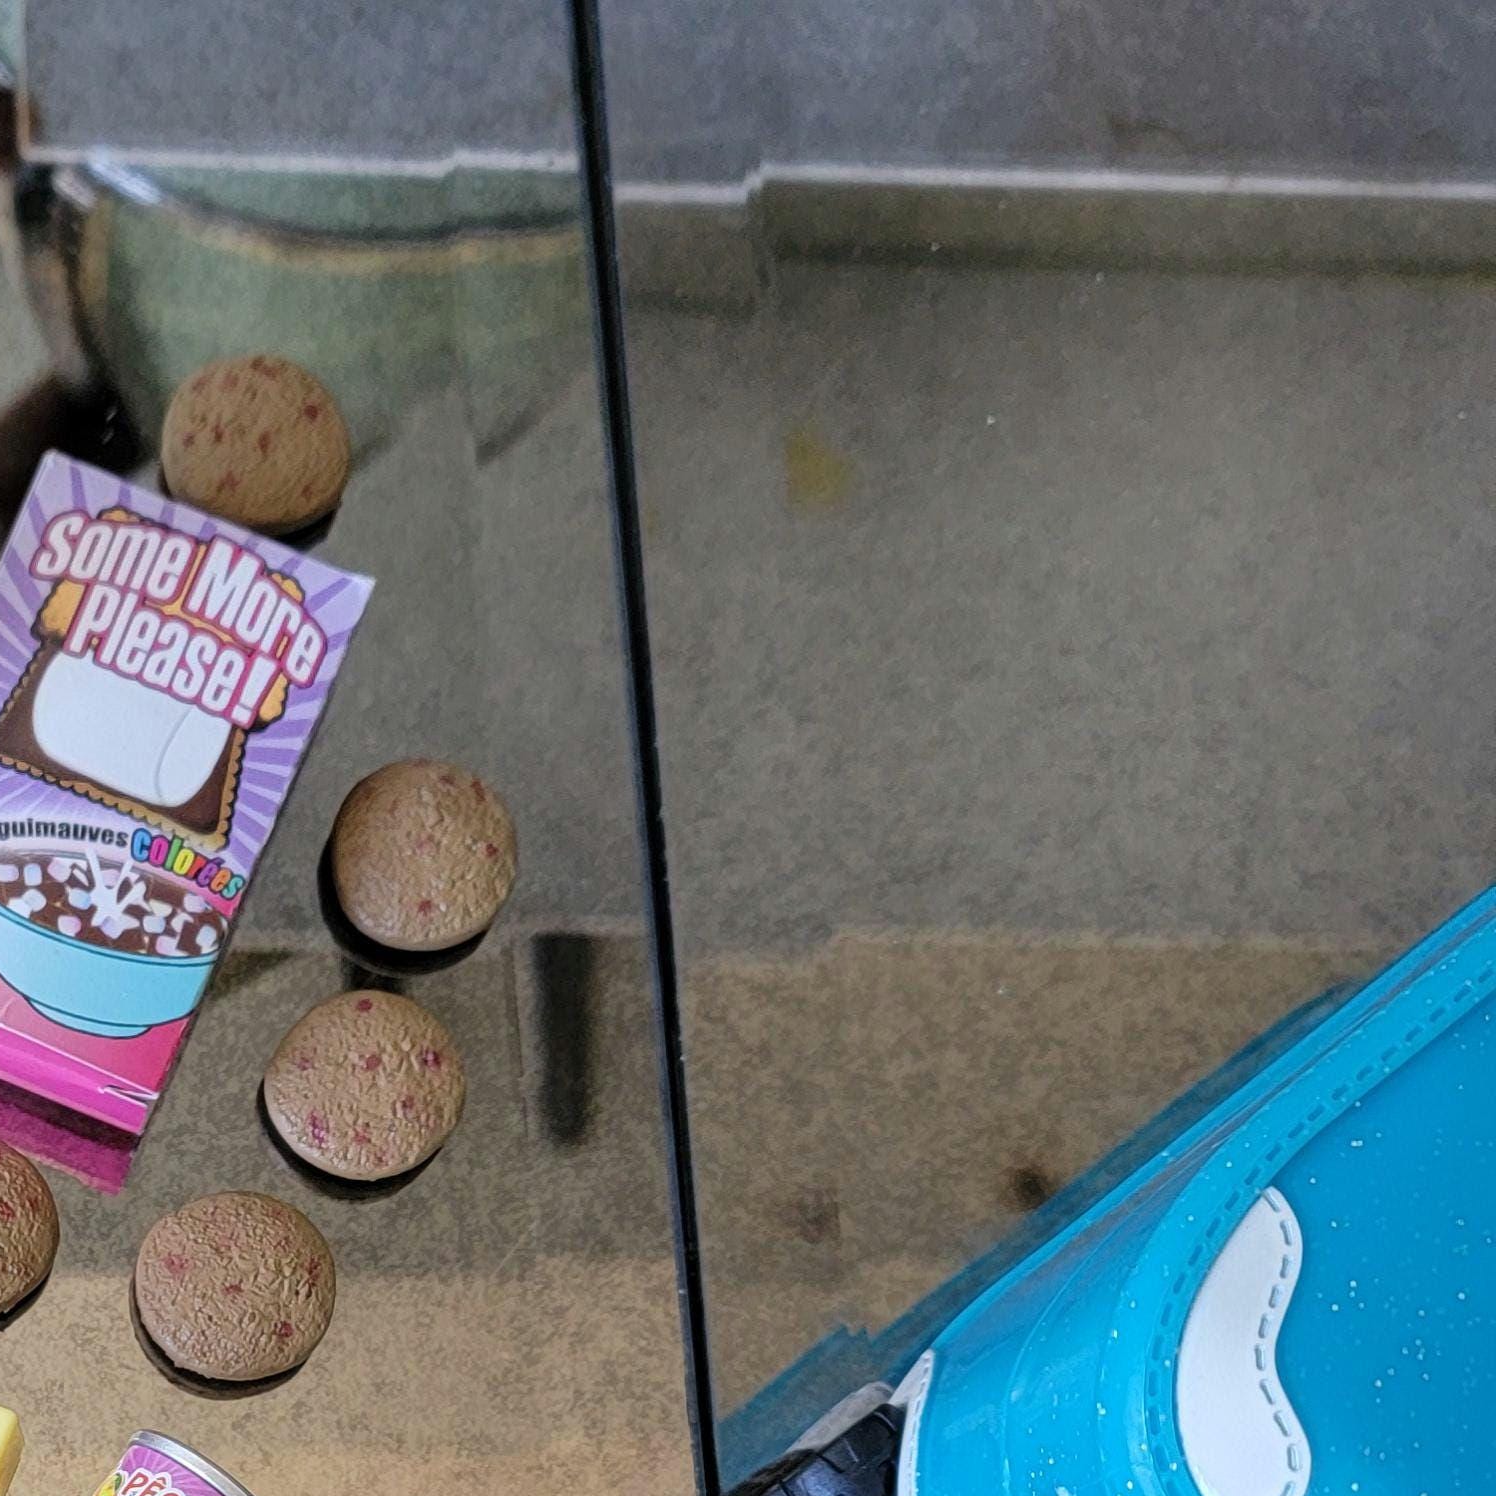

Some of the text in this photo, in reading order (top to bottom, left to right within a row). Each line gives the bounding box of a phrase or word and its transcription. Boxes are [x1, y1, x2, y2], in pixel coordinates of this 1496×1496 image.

[31, 510, 326, 686] Some More
[65, 583, 280, 727] Please!
[130, 827, 246, 900] Colorées
